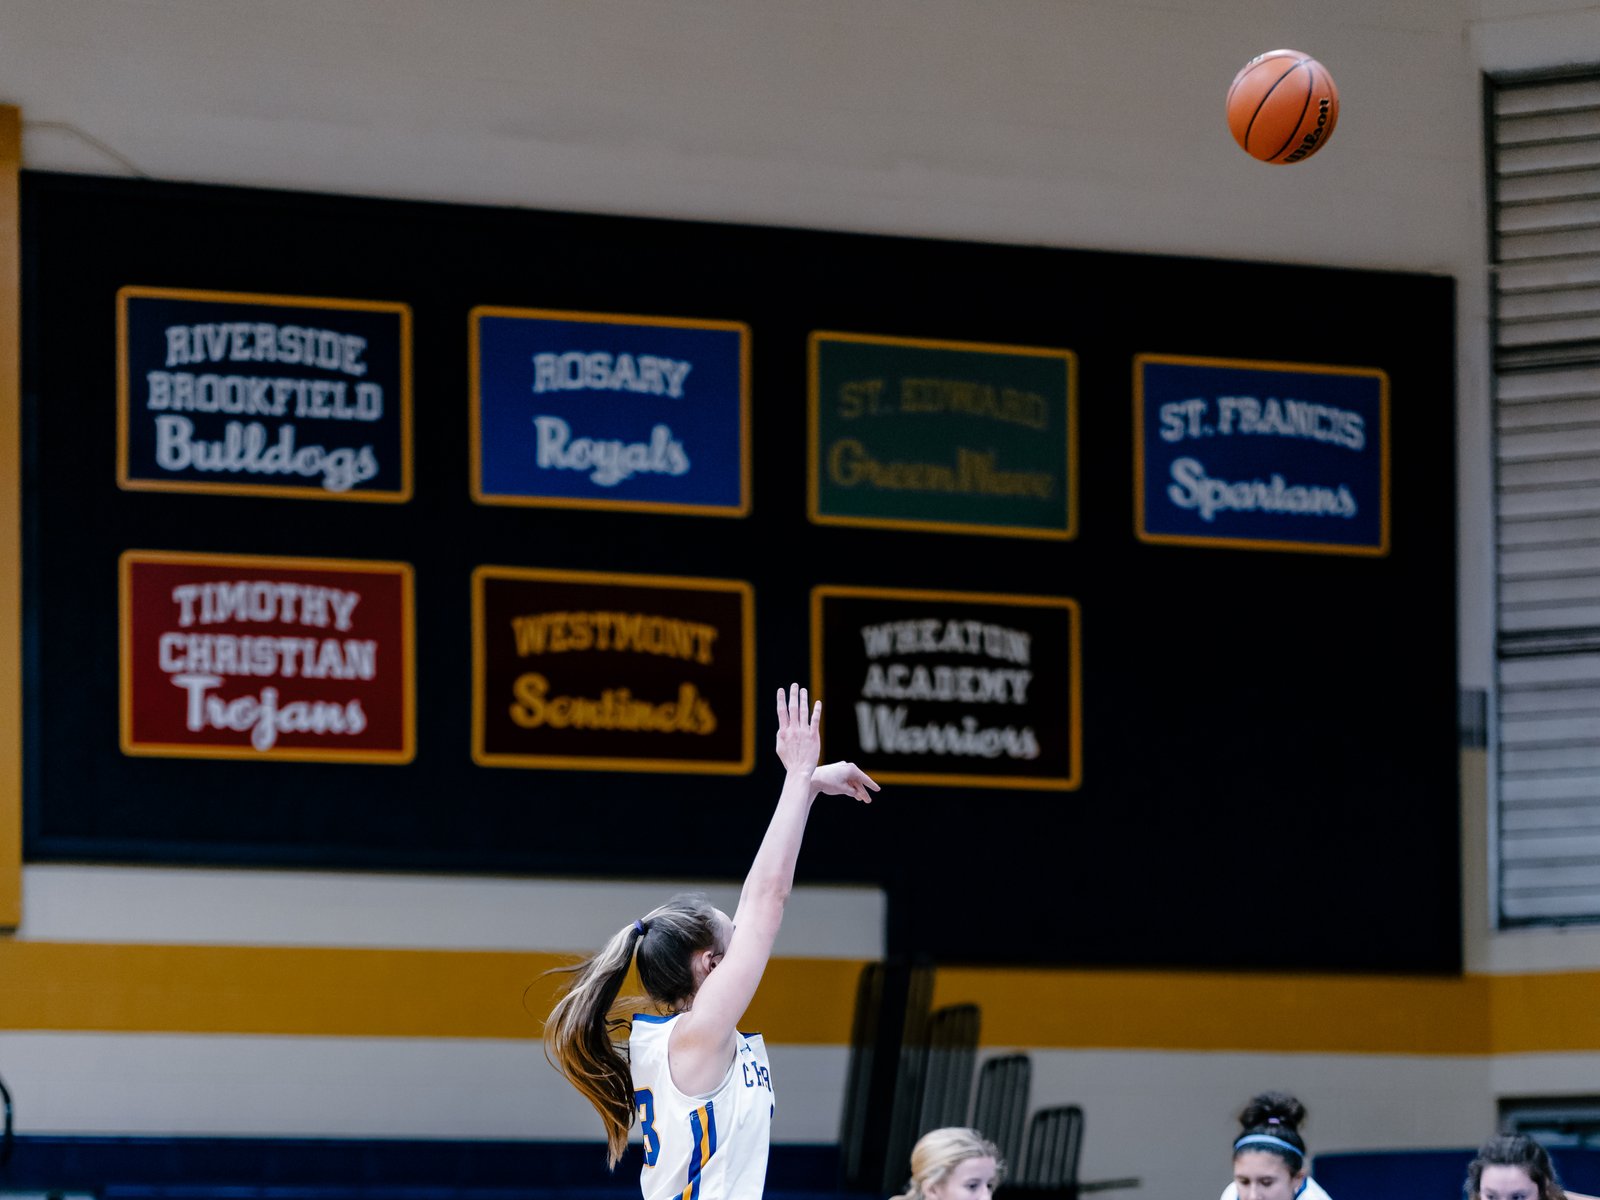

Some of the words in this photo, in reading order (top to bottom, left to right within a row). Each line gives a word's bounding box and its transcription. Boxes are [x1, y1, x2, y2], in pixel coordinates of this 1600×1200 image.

[164, 322, 367, 376] RIVERSIDE
[532, 351, 692, 399] ROSARY
[147, 370, 383, 421] BROOKFIELD
[1158, 397, 1215, 442] ST.
[1216, 394, 1366, 451] FRANCIS
[155, 414, 379, 493] Bulldogs
[532, 414, 691, 487] Royals
[1167, 457, 1357, 523] Spartans
[171, 580, 361, 632] TIMOTHY
[158, 631, 377, 681] CHRISTIAN
[511, 610, 718, 666] WESTMONT
[860, 617, 1032, 667] WHEATON
[509, 671, 718, 736] Sentinels
[860, 662, 1034, 706] ACADEMY
[169, 673, 367, 752] Trojans
[854, 699, 1041, 761] Warriors
